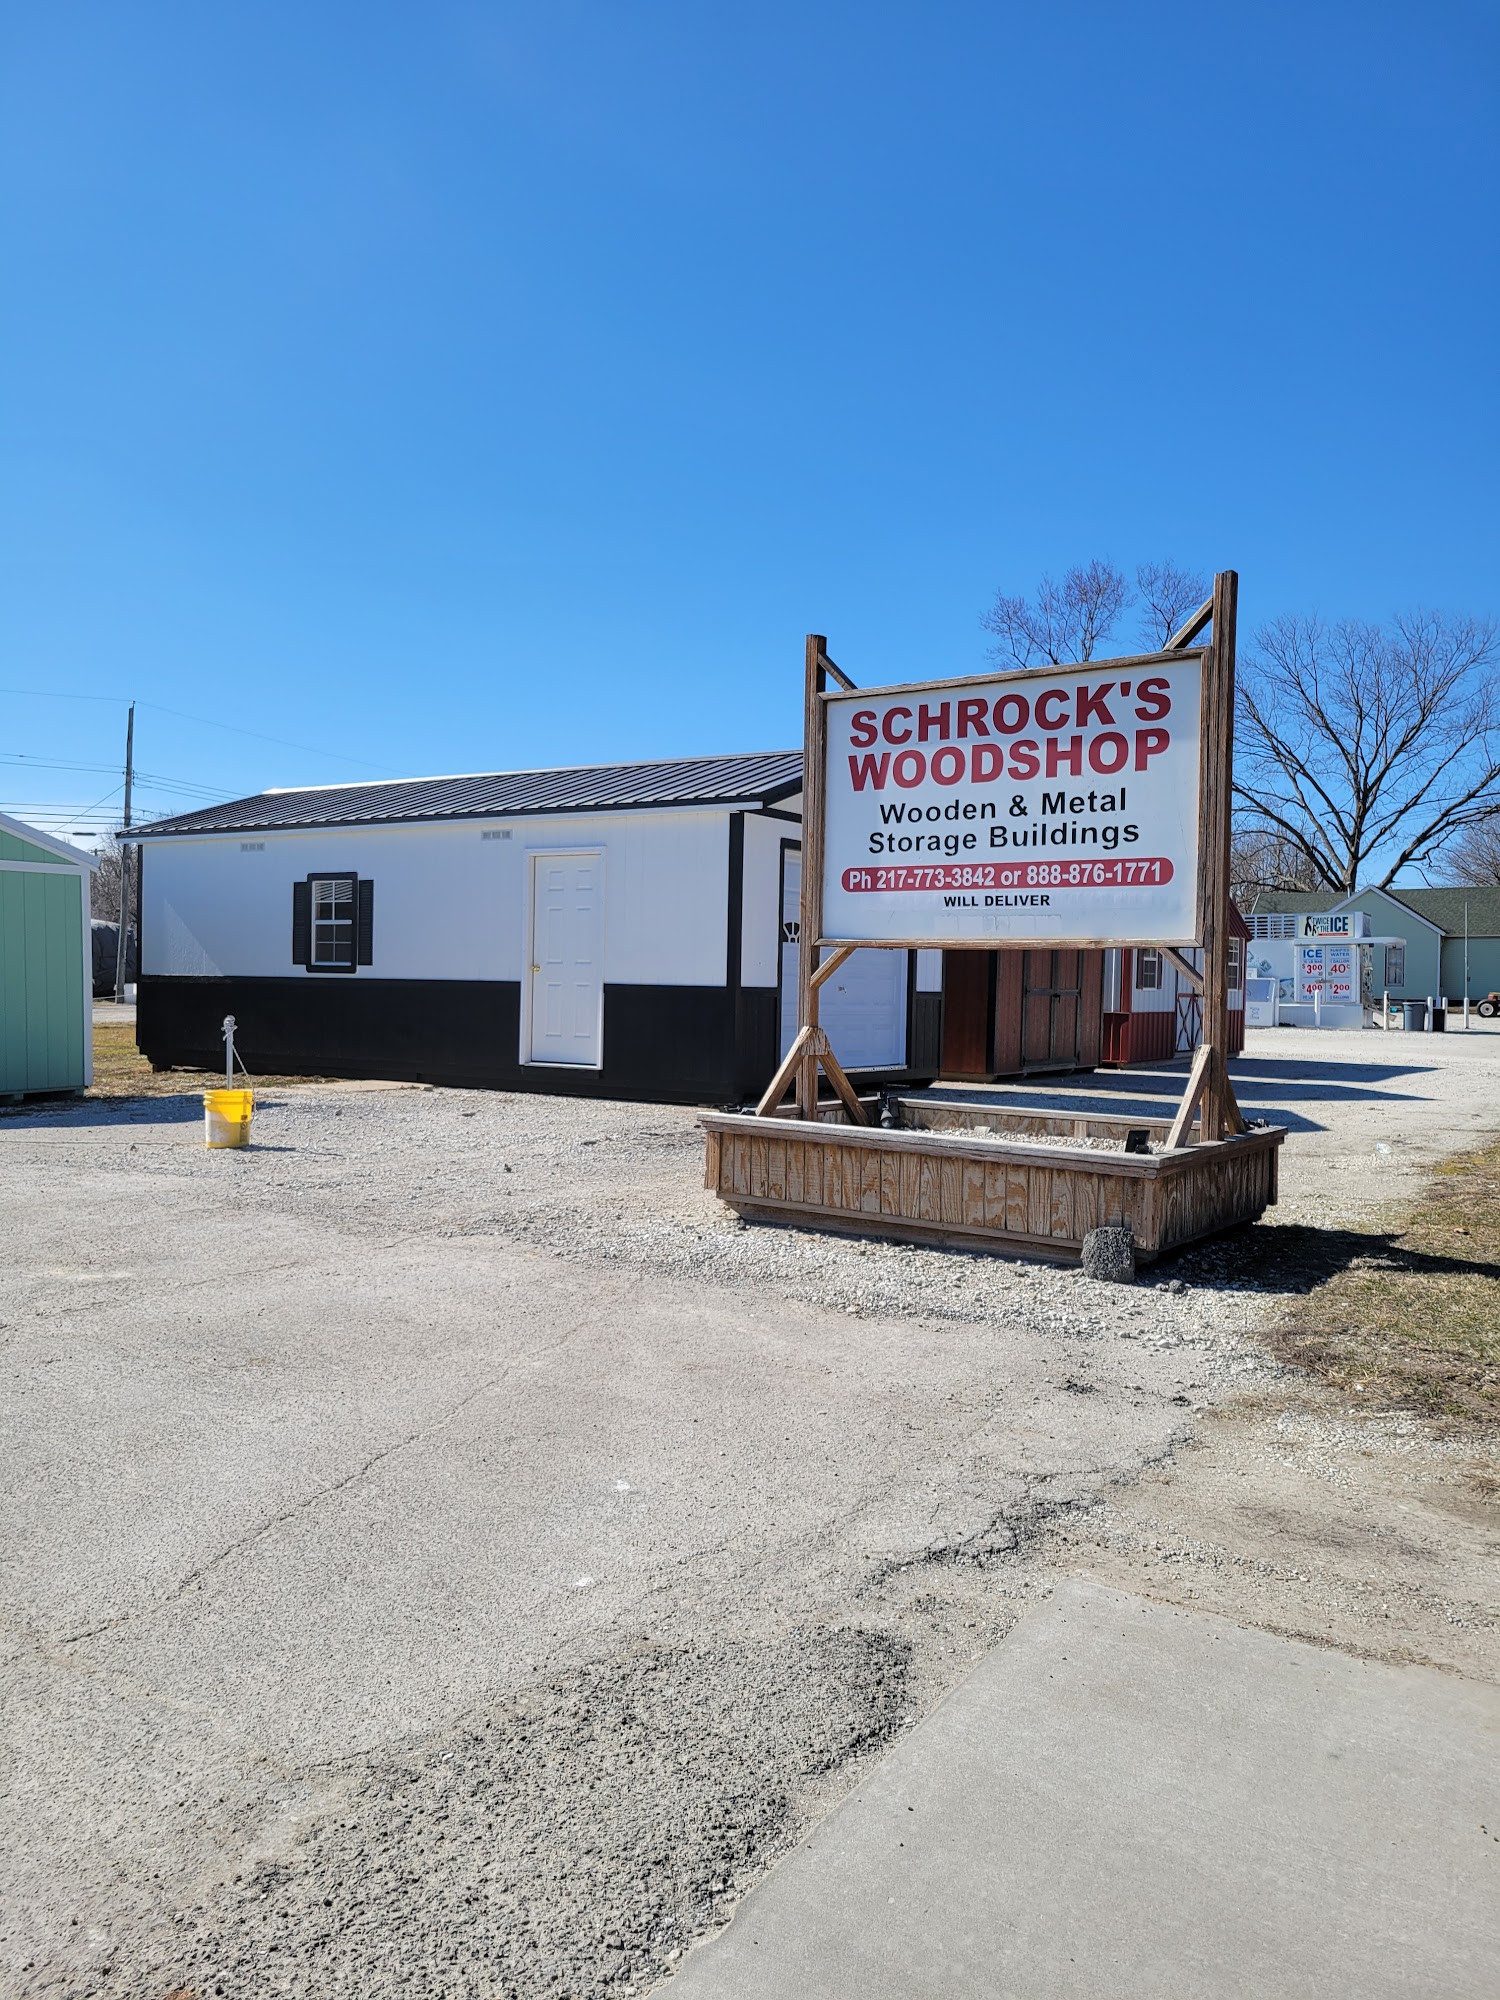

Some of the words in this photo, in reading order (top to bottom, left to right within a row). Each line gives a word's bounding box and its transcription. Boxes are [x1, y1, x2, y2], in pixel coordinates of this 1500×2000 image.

[849, 677, 1172, 748] SCHROCK'S
[848, 728, 1171, 792] WOODSHOP
[880, 799, 997, 824] Wooden
[1008, 794, 1028, 817] &
[1041, 787, 1127, 815] Metal
[868, 831, 978, 856] Storage
[989, 821, 1140, 850] Buildings
[848, 870, 872, 890] Ph
[876, 867, 995, 889] 217-773-3842
[1000, 870, 1019, 885] or
[1026, 861, 1161, 884] 888-876-1771
[944, 896, 979, 907] WILL
[984, 895, 1051, 907] DELIVER
[1330, 916, 1348, 932] ICE
[1303, 949, 1322, 958] ICE
